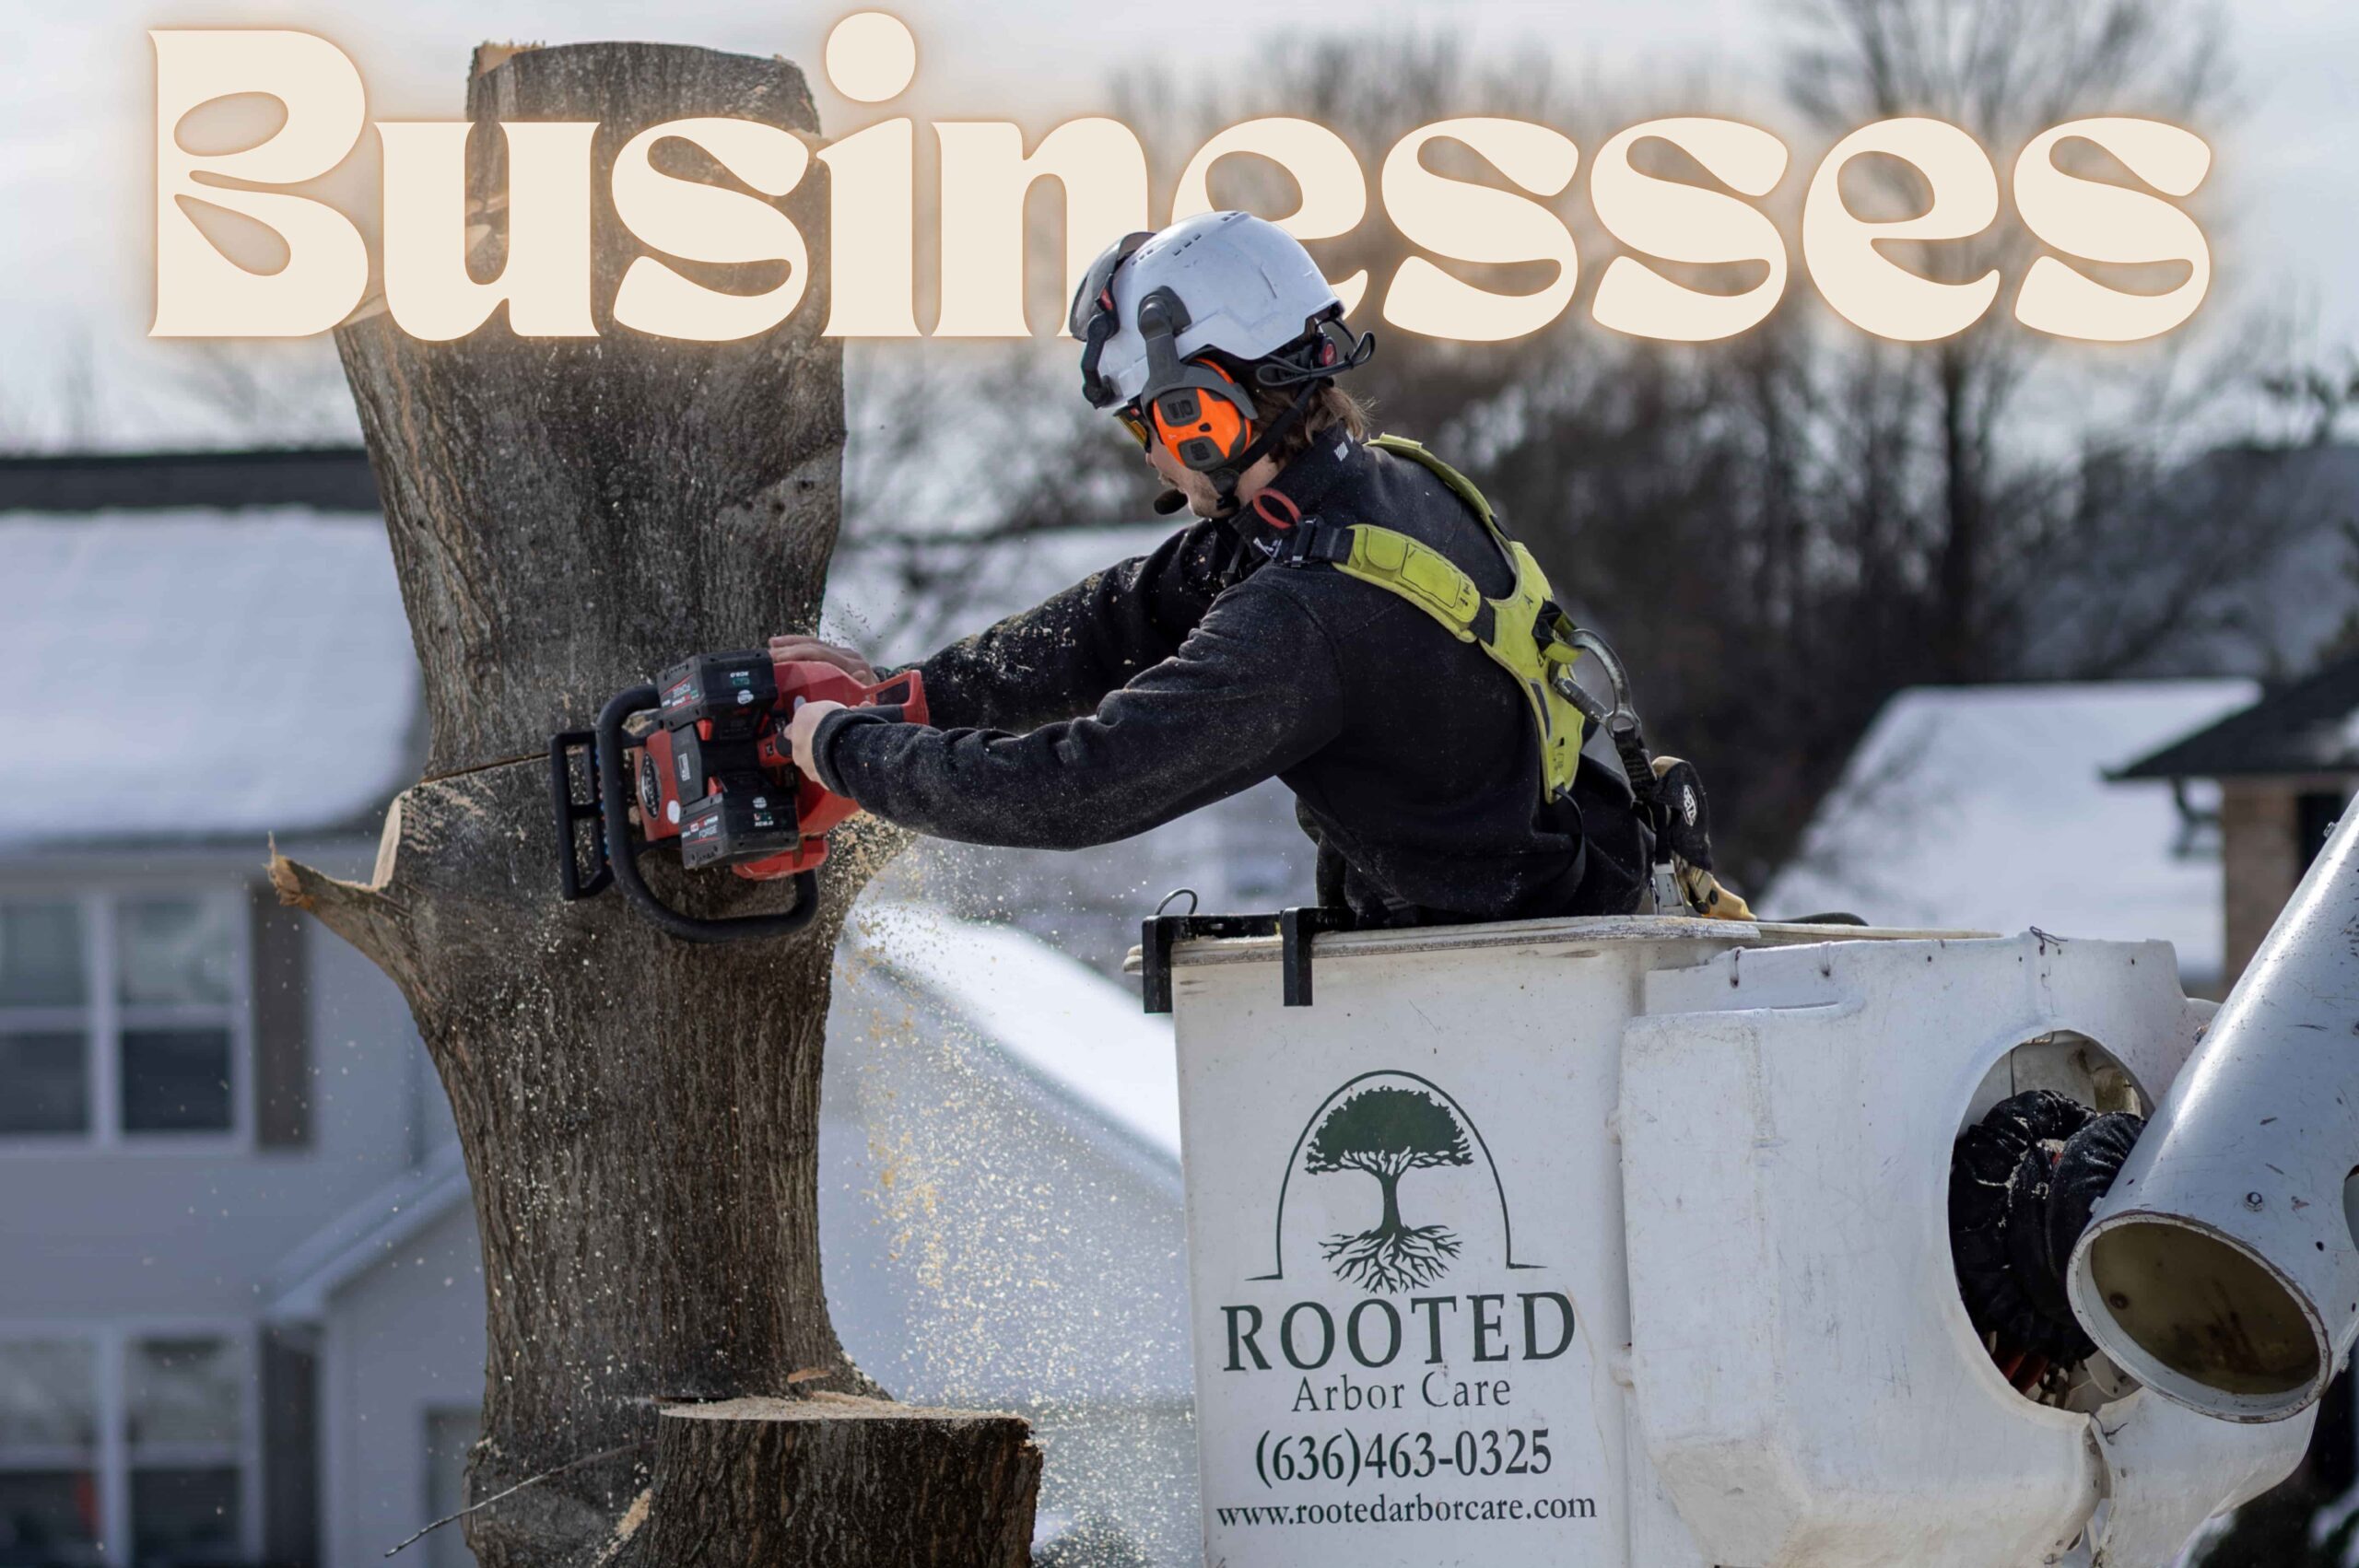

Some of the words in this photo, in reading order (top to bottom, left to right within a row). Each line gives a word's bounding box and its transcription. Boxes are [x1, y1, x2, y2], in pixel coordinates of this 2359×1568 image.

[1219, 1291, 1576, 1372] ROOTED
[1291, 1373, 1405, 1412] Arbor
[1421, 1371, 1511, 1408] Care
[1255, 1427, 1553, 1489] (636)463-0325
[1216, 1492, 1597, 1527] www.rootedarborcare.com
